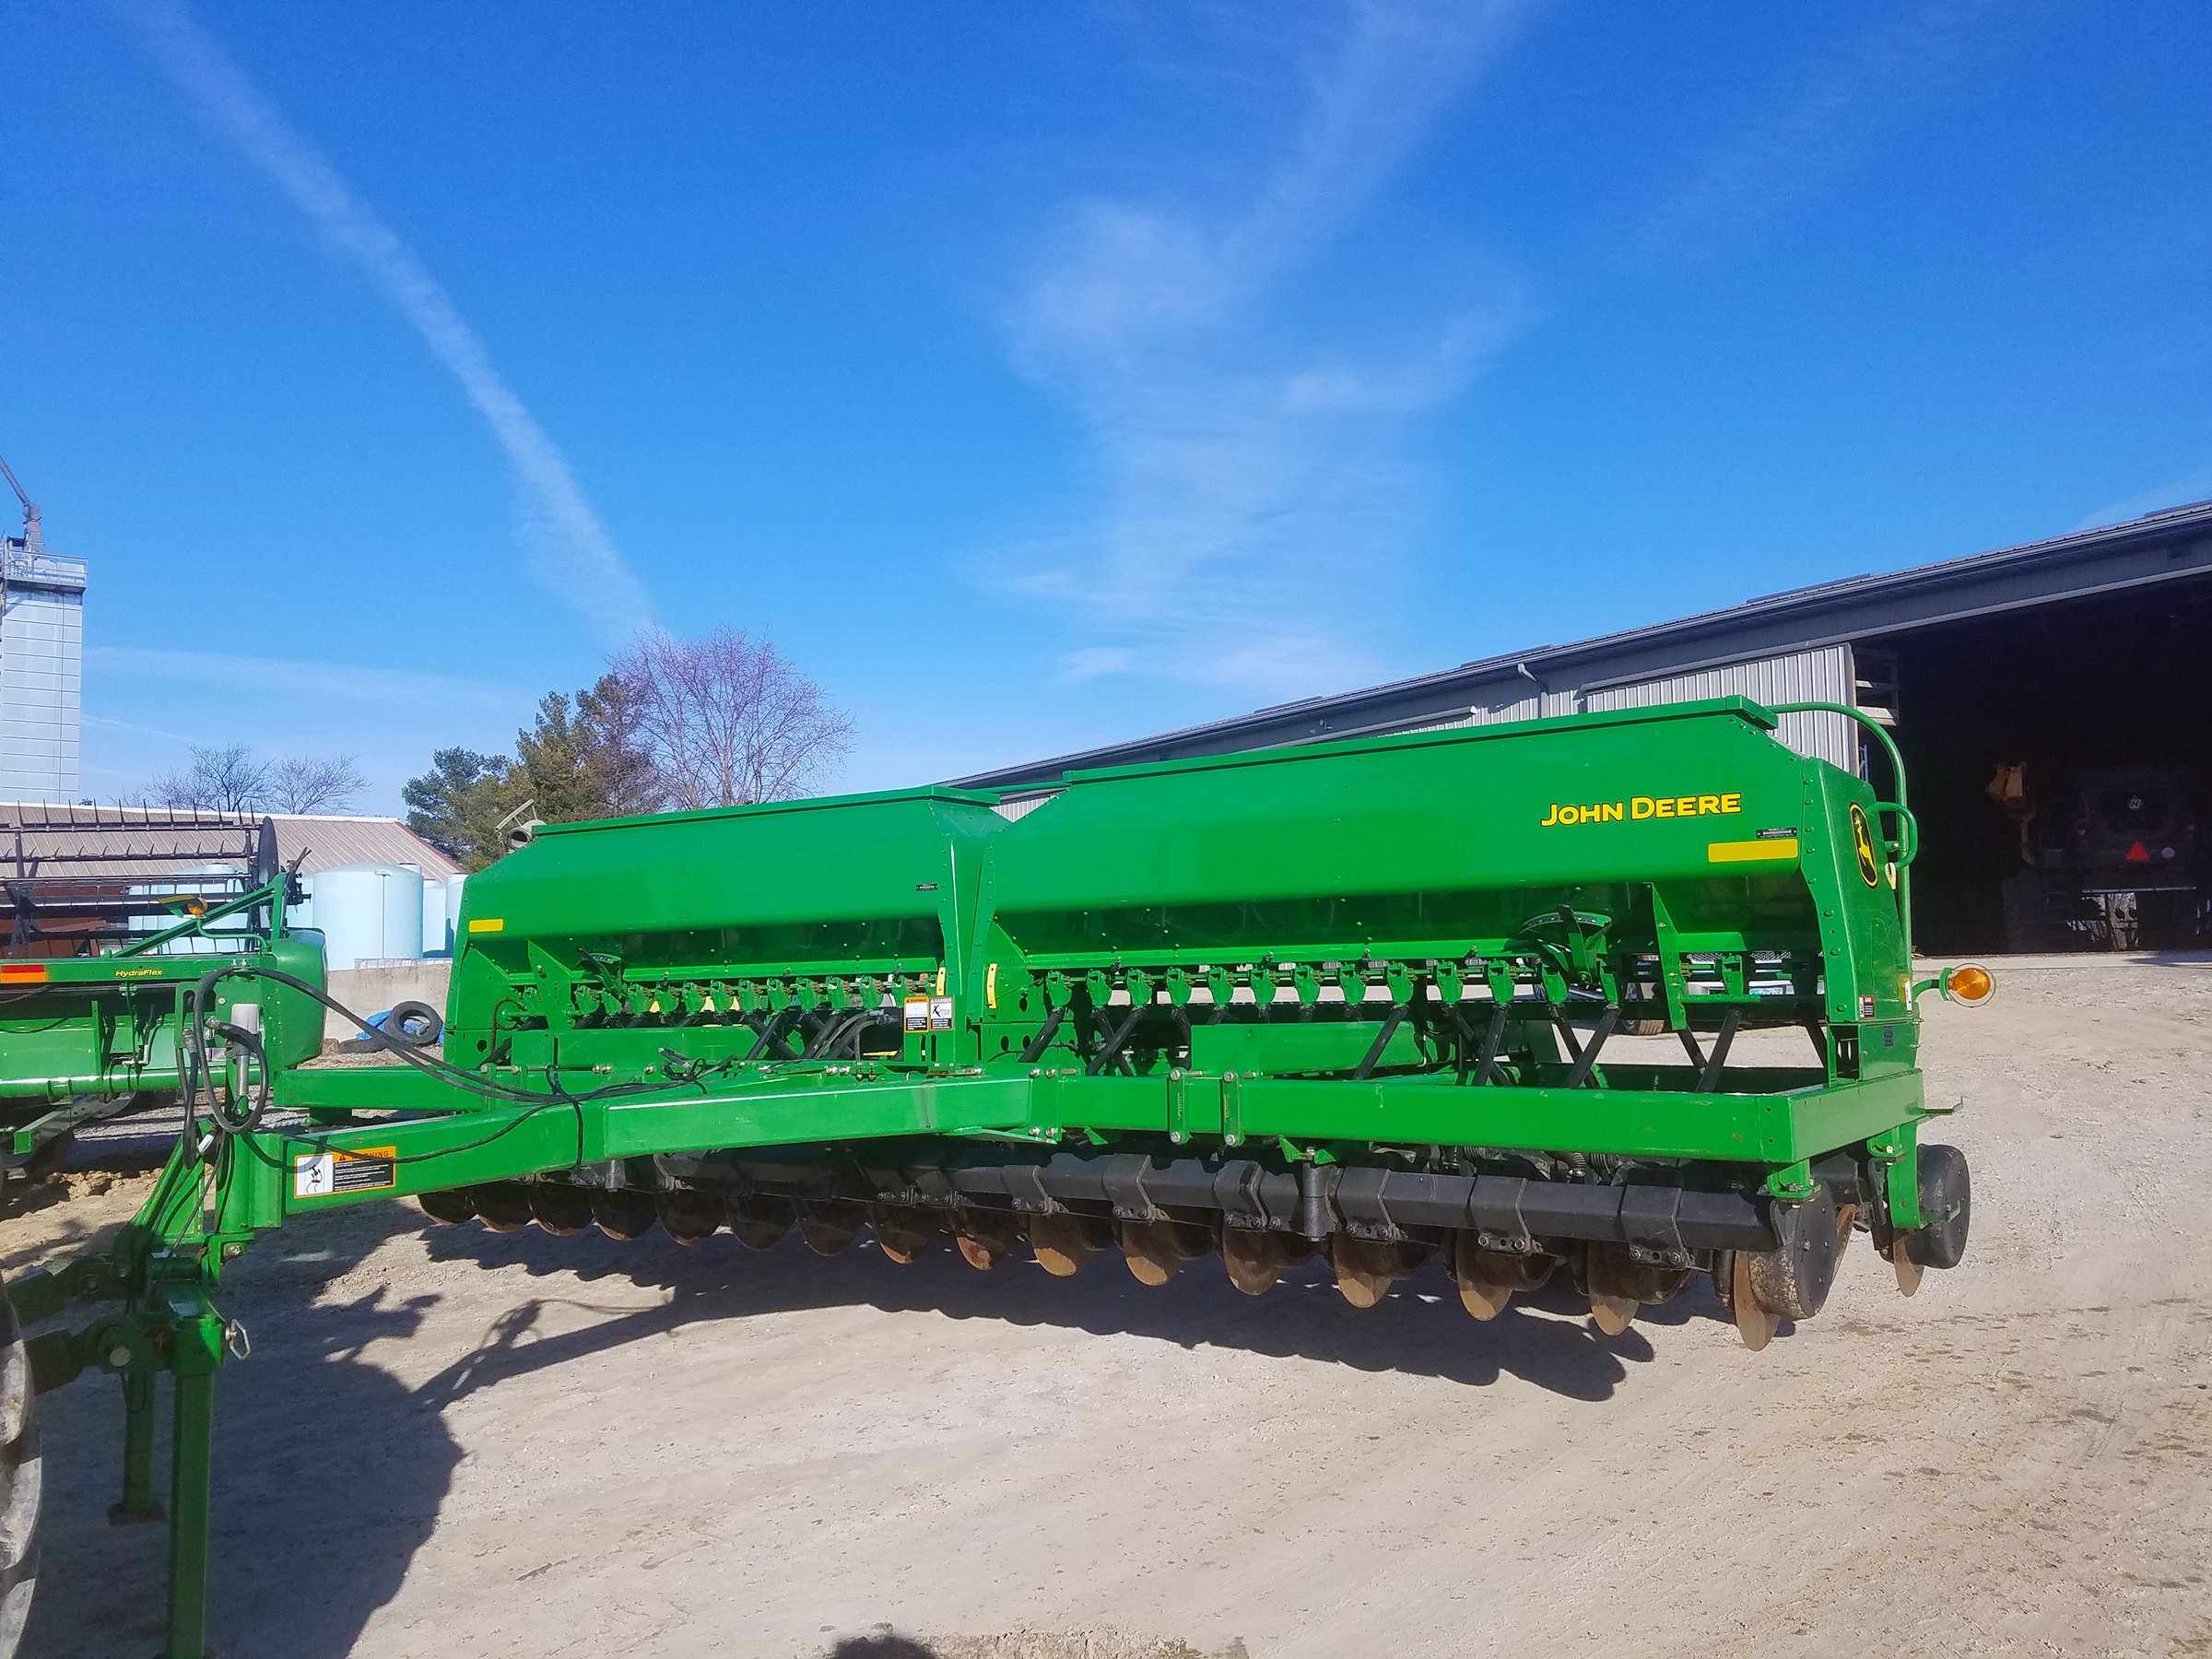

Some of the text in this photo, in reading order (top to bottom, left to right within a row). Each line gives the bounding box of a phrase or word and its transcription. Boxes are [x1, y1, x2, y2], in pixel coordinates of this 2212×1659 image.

[1540, 793, 1741, 827] JOHN DEERE
[115, 969, 163, 978] HydraFlex
